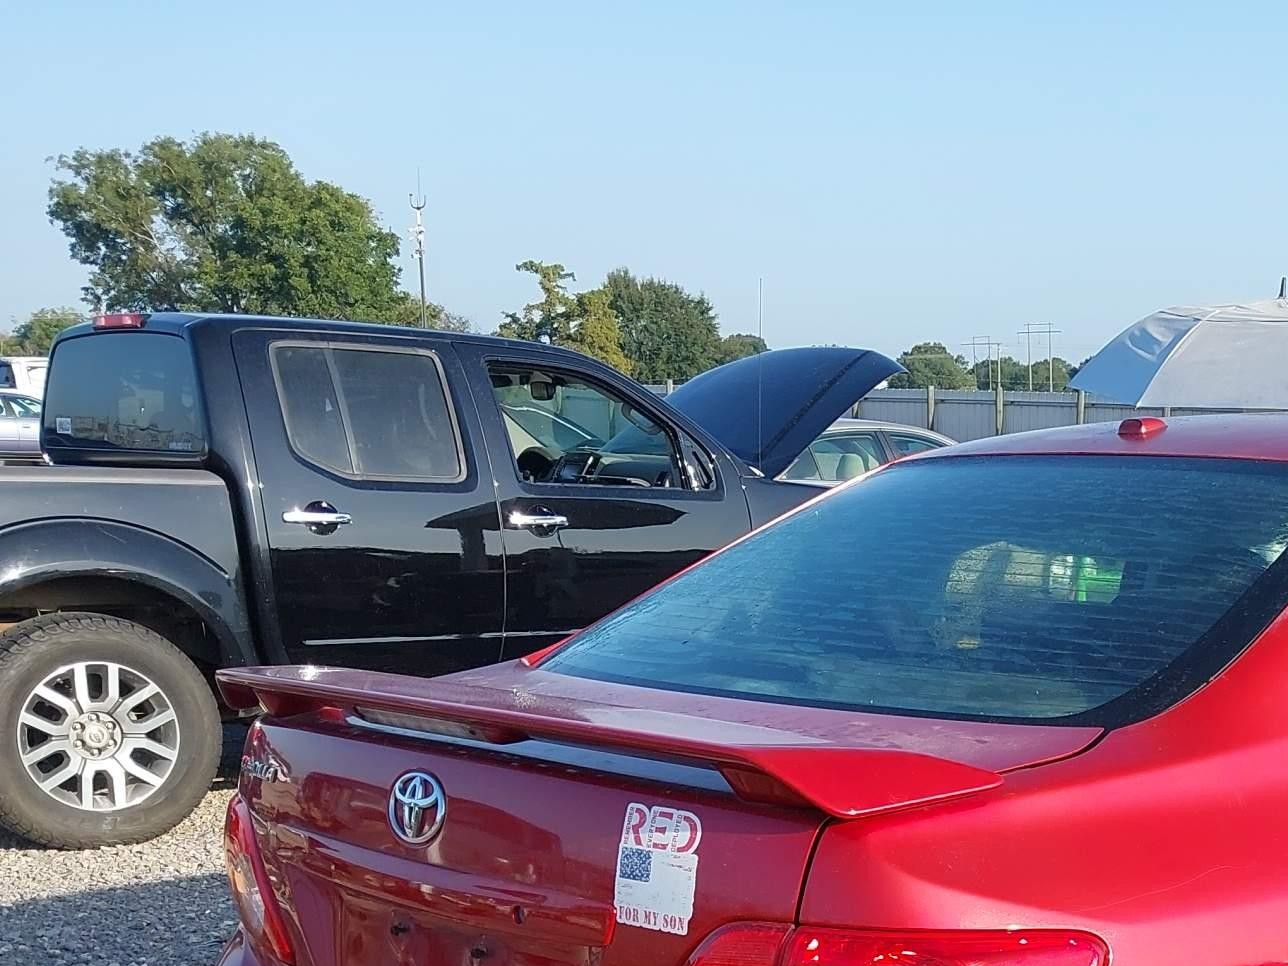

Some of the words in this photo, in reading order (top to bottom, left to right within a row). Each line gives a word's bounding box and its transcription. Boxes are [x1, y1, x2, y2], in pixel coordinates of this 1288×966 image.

[623, 807, 635, 845] REMEMBER
[626, 807, 699, 854] RED
[647, 809, 659, 849] EVERYONE
[670, 814, 683, 853] DEPLOYED
[619, 905, 640, 923] FOR
[643, 910, 659, 927] MY
[662, 913, 685, 932] SON
